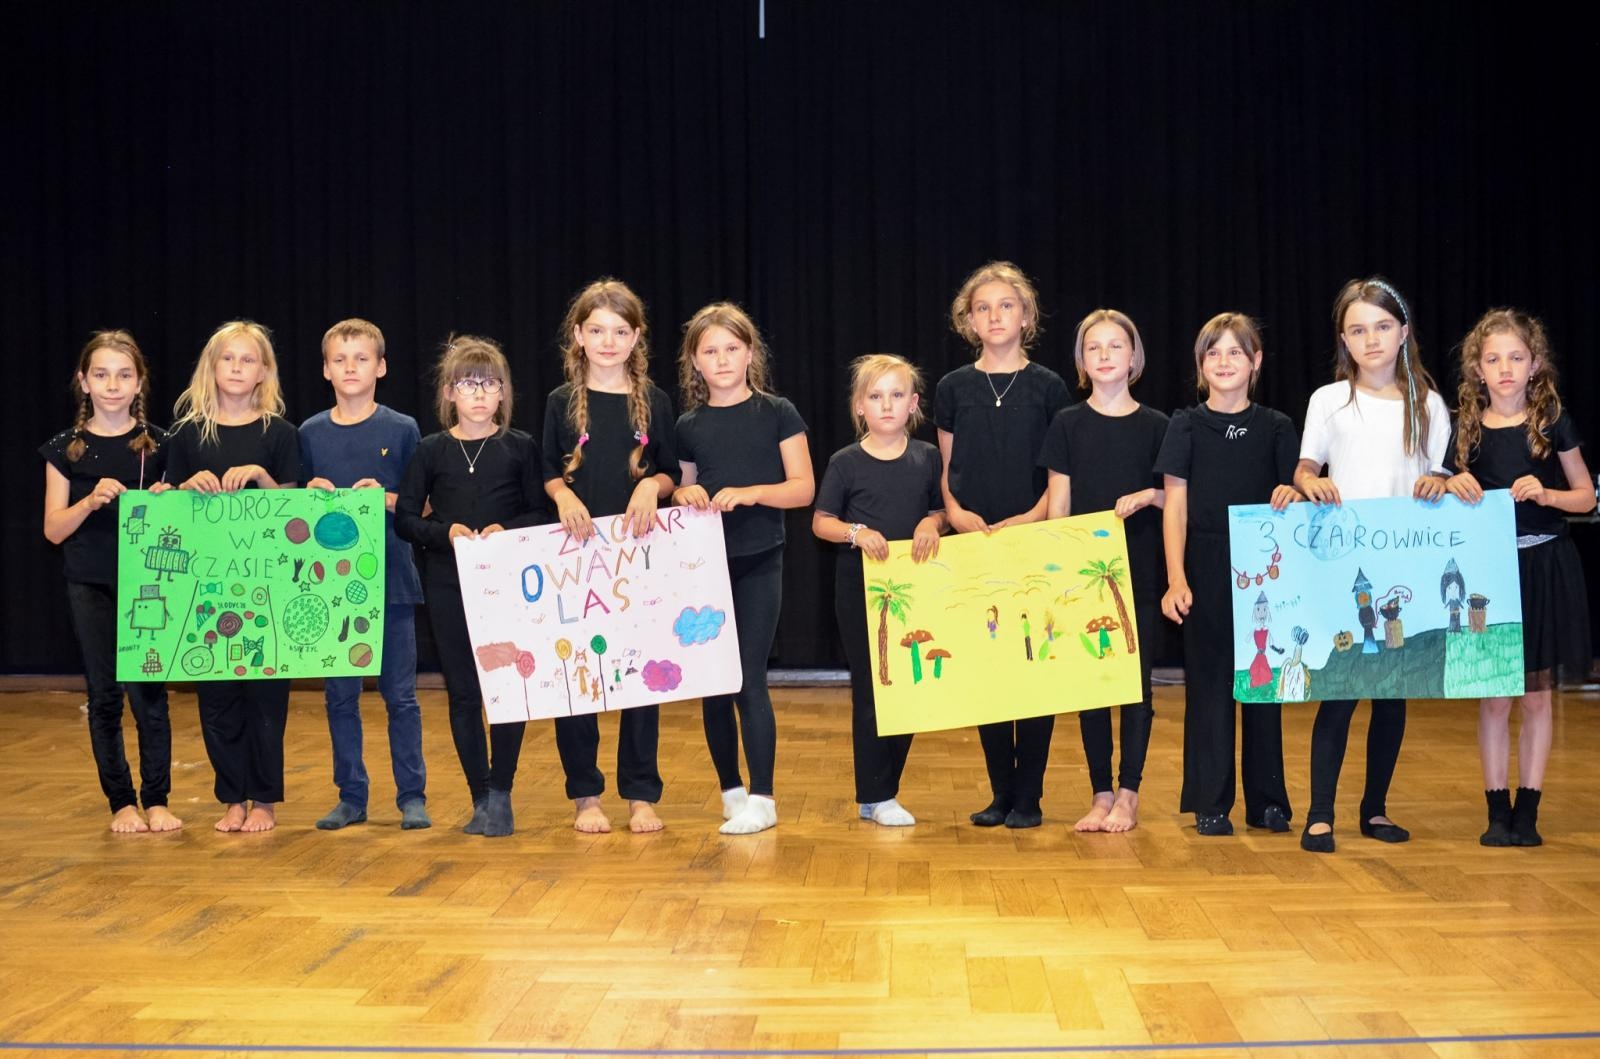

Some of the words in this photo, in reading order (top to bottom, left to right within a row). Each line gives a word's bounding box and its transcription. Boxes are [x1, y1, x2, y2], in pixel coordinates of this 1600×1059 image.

[192, 490, 293, 524] PODRÓŻ
[228, 530, 256, 550] W
[1259, 520, 1278, 553] 3
[191, 555, 274, 579] CZASIE
[521, 544, 651, 603] OWANY
[556, 576, 631, 625] LAS
